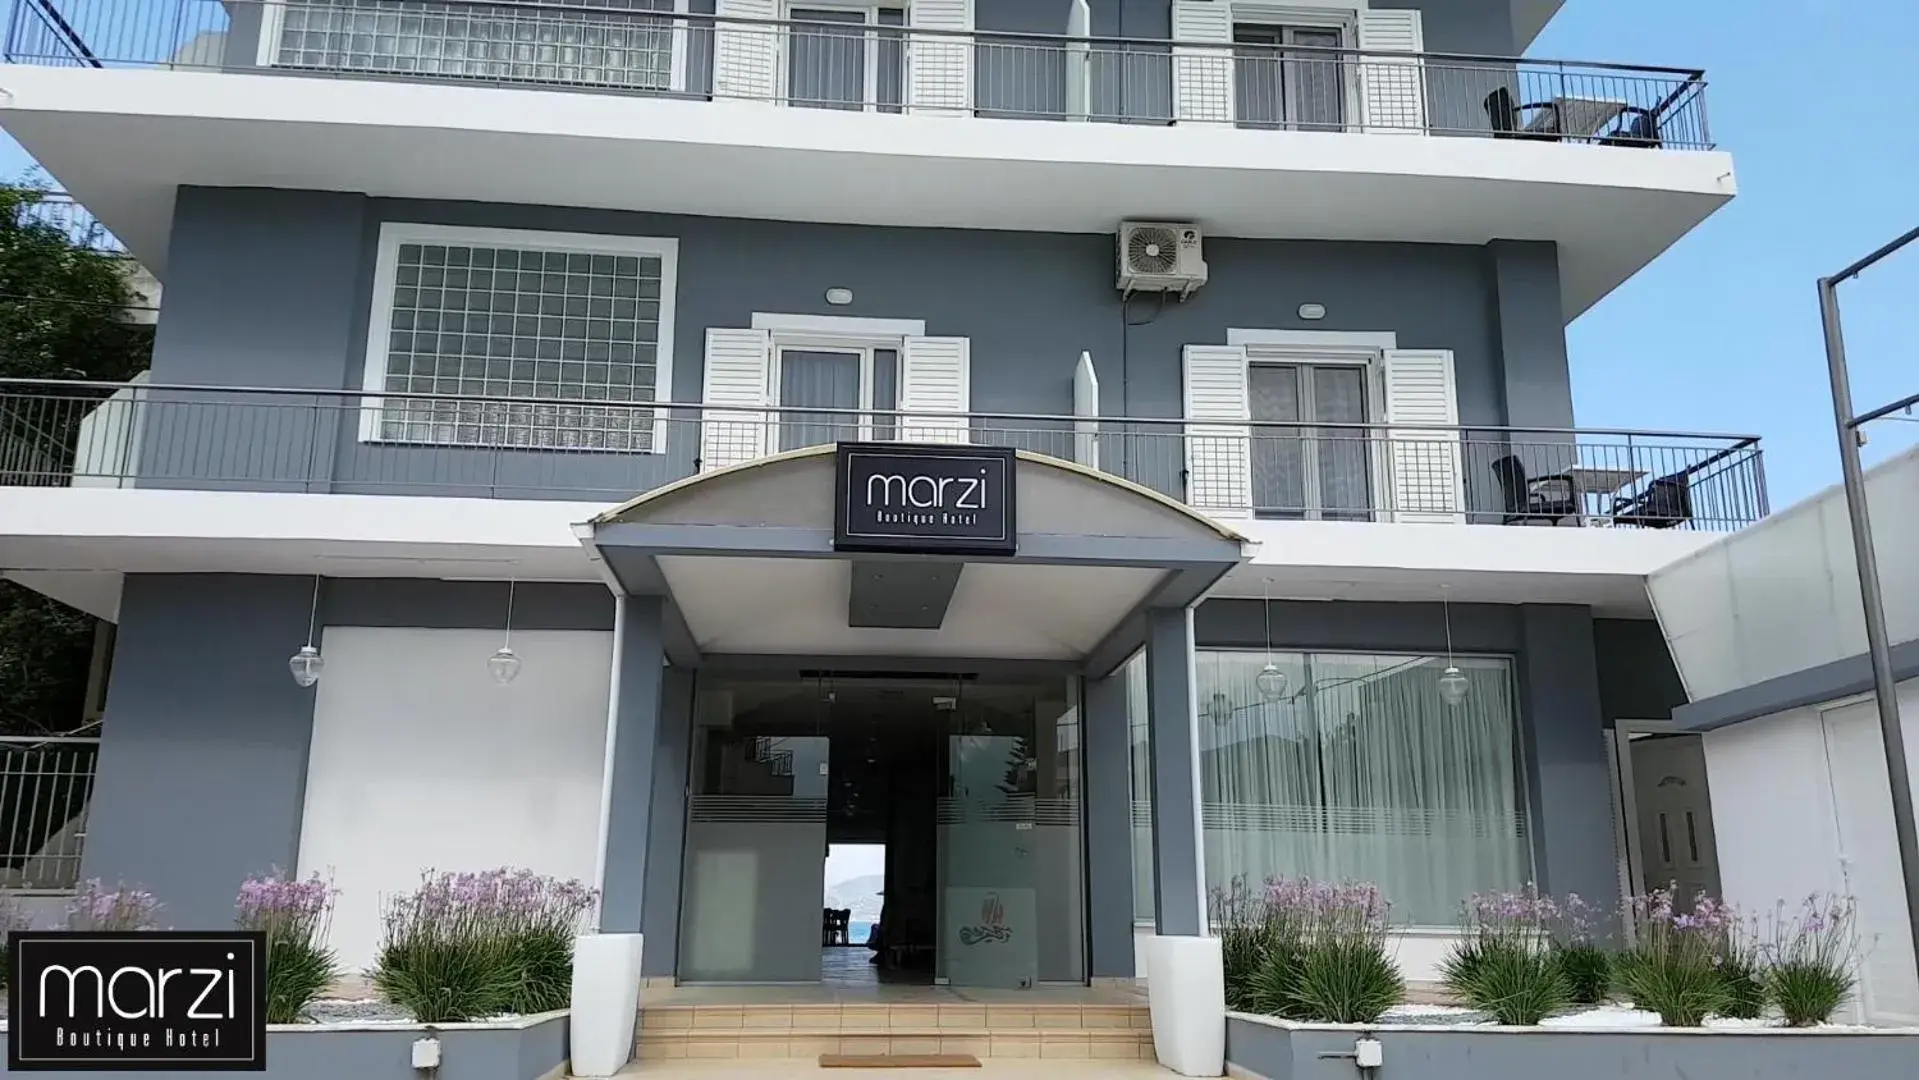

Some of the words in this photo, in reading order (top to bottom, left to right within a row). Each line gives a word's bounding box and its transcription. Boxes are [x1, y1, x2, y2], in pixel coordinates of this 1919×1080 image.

[867, 468, 986, 509] marzi
[877, 510, 935, 526] Boutique
[942, 512, 977, 526] Hotel
